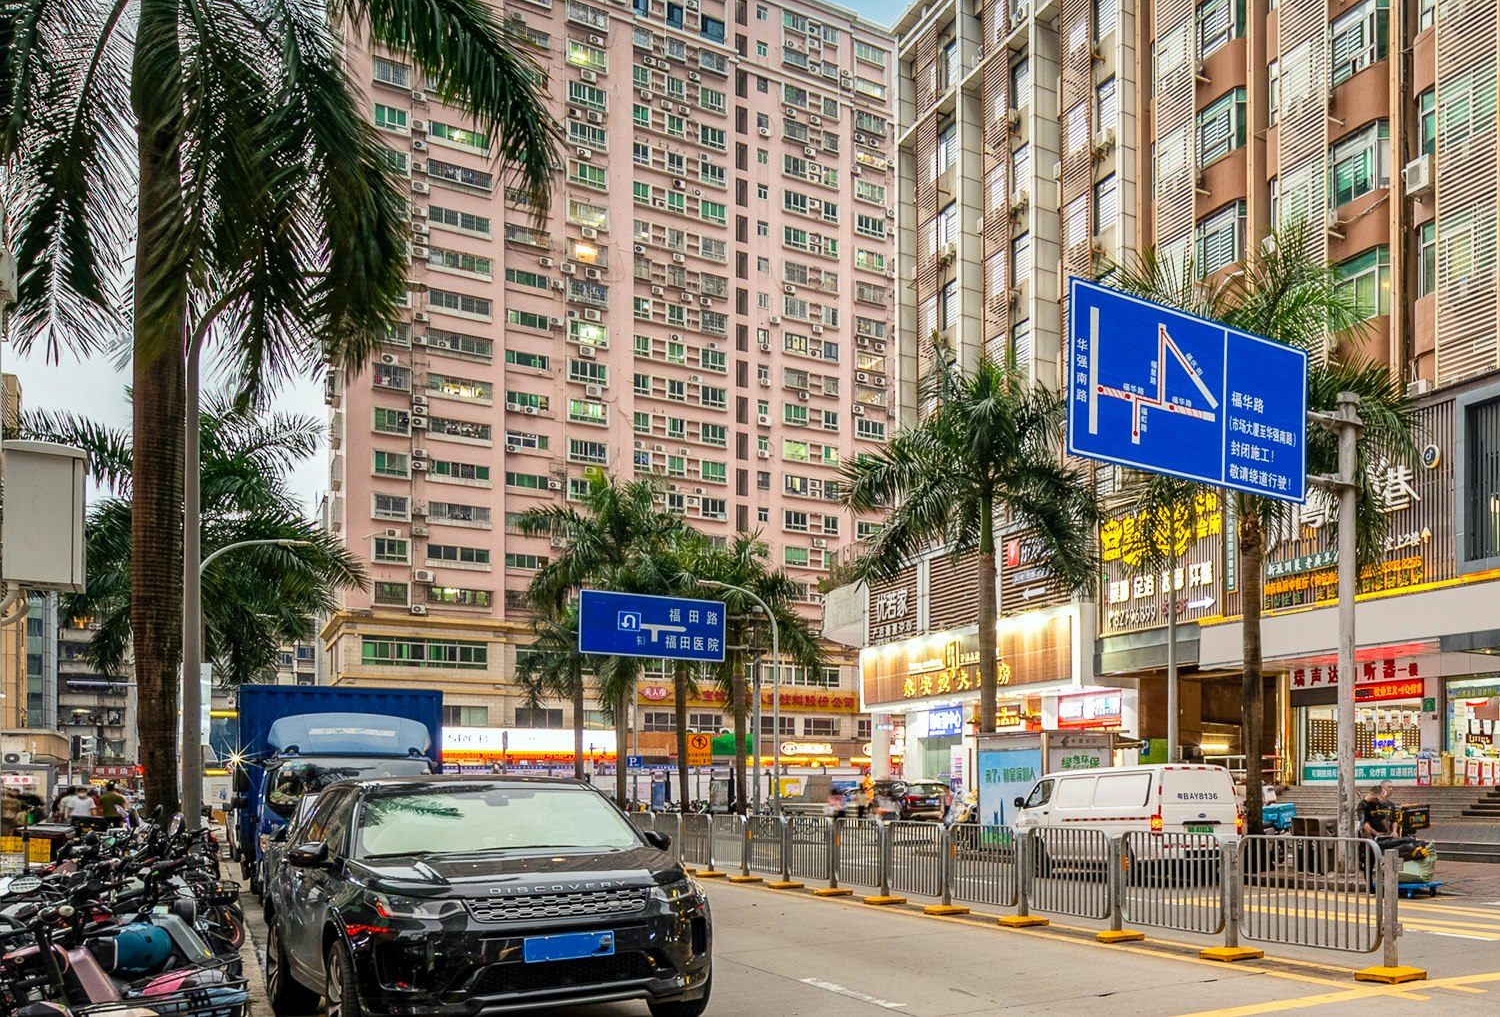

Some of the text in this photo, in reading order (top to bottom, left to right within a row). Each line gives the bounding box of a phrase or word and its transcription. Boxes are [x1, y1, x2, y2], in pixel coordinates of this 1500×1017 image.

[1076, 338, 1088, 403] 华强南路
[1231, 391, 1264, 414] 福华路
[669, 607, 718, 626] 福田路
[665, 634, 720, 652] 福田医院
[1294, 659, 1419, 687] 瑞声达听器一楼
[1061, 755, 1101, 768] 绿色环保
[489, 881, 626, 895] DISCOVERY
